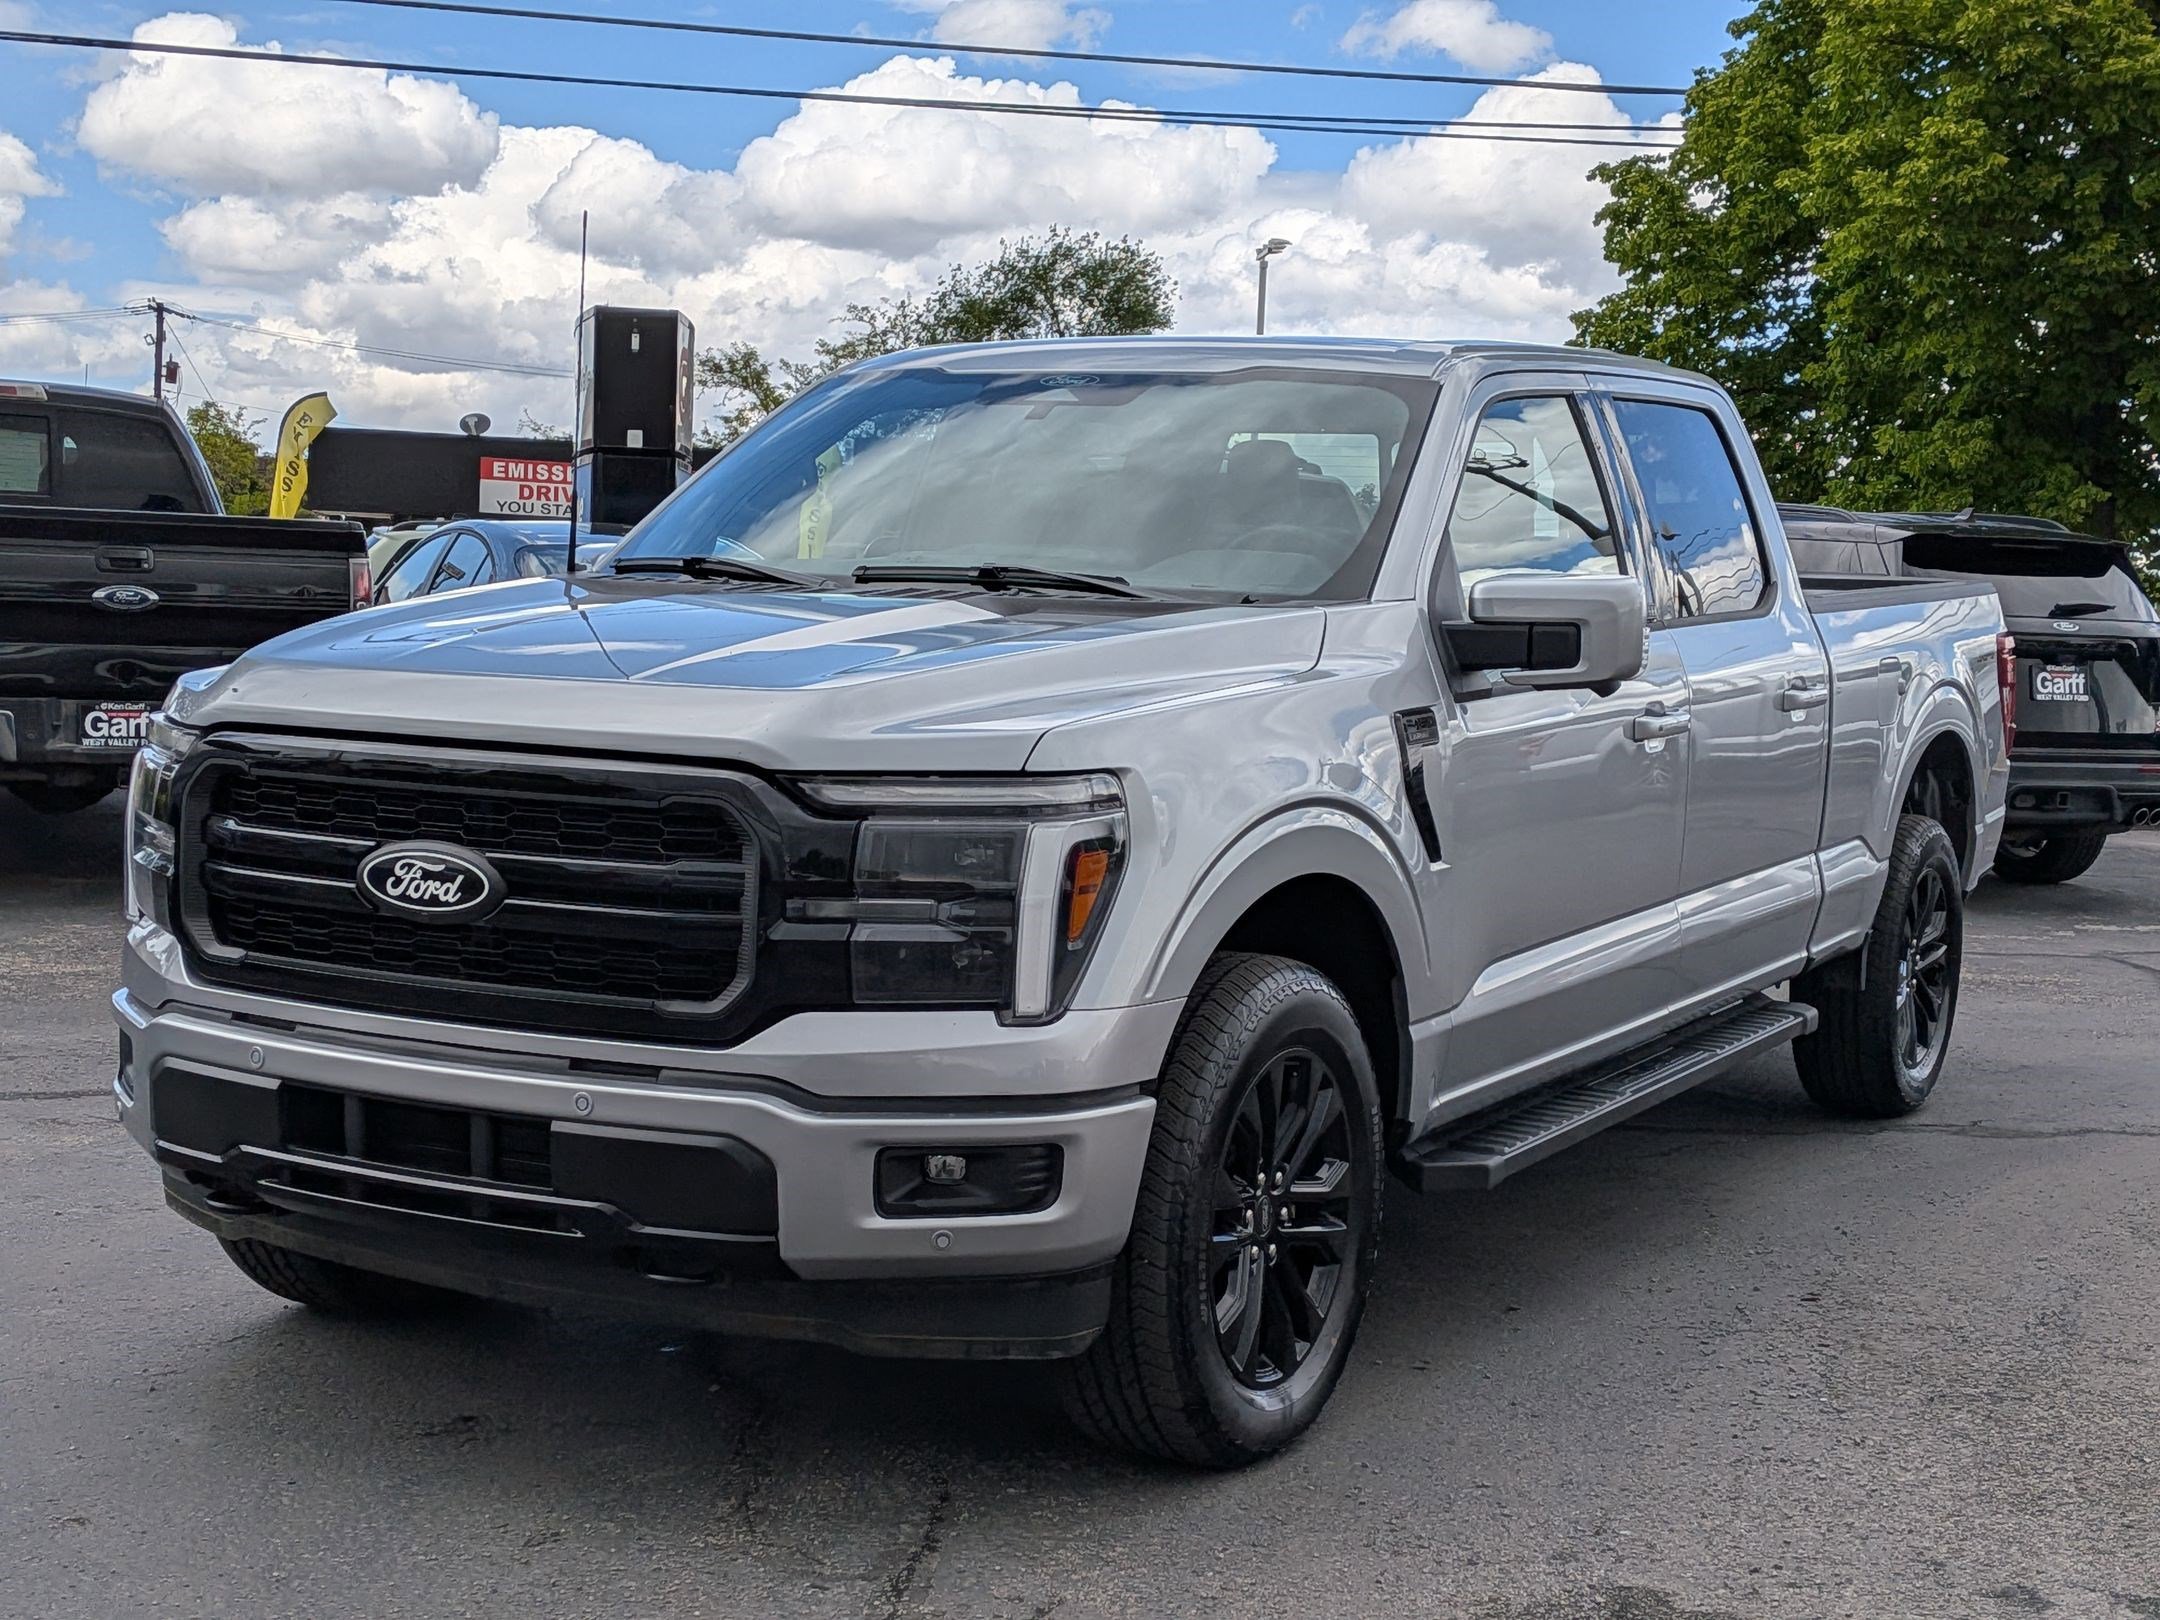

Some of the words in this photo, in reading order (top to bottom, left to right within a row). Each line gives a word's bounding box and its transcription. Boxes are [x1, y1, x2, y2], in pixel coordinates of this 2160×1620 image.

[496, 500, 535, 514] YOU
[2036, 671, 2085, 694] Garff
[82, 738, 106, 747] WEST
[107, 738, 140, 747] VALLEY
[386, 859, 464, 903] Ford
